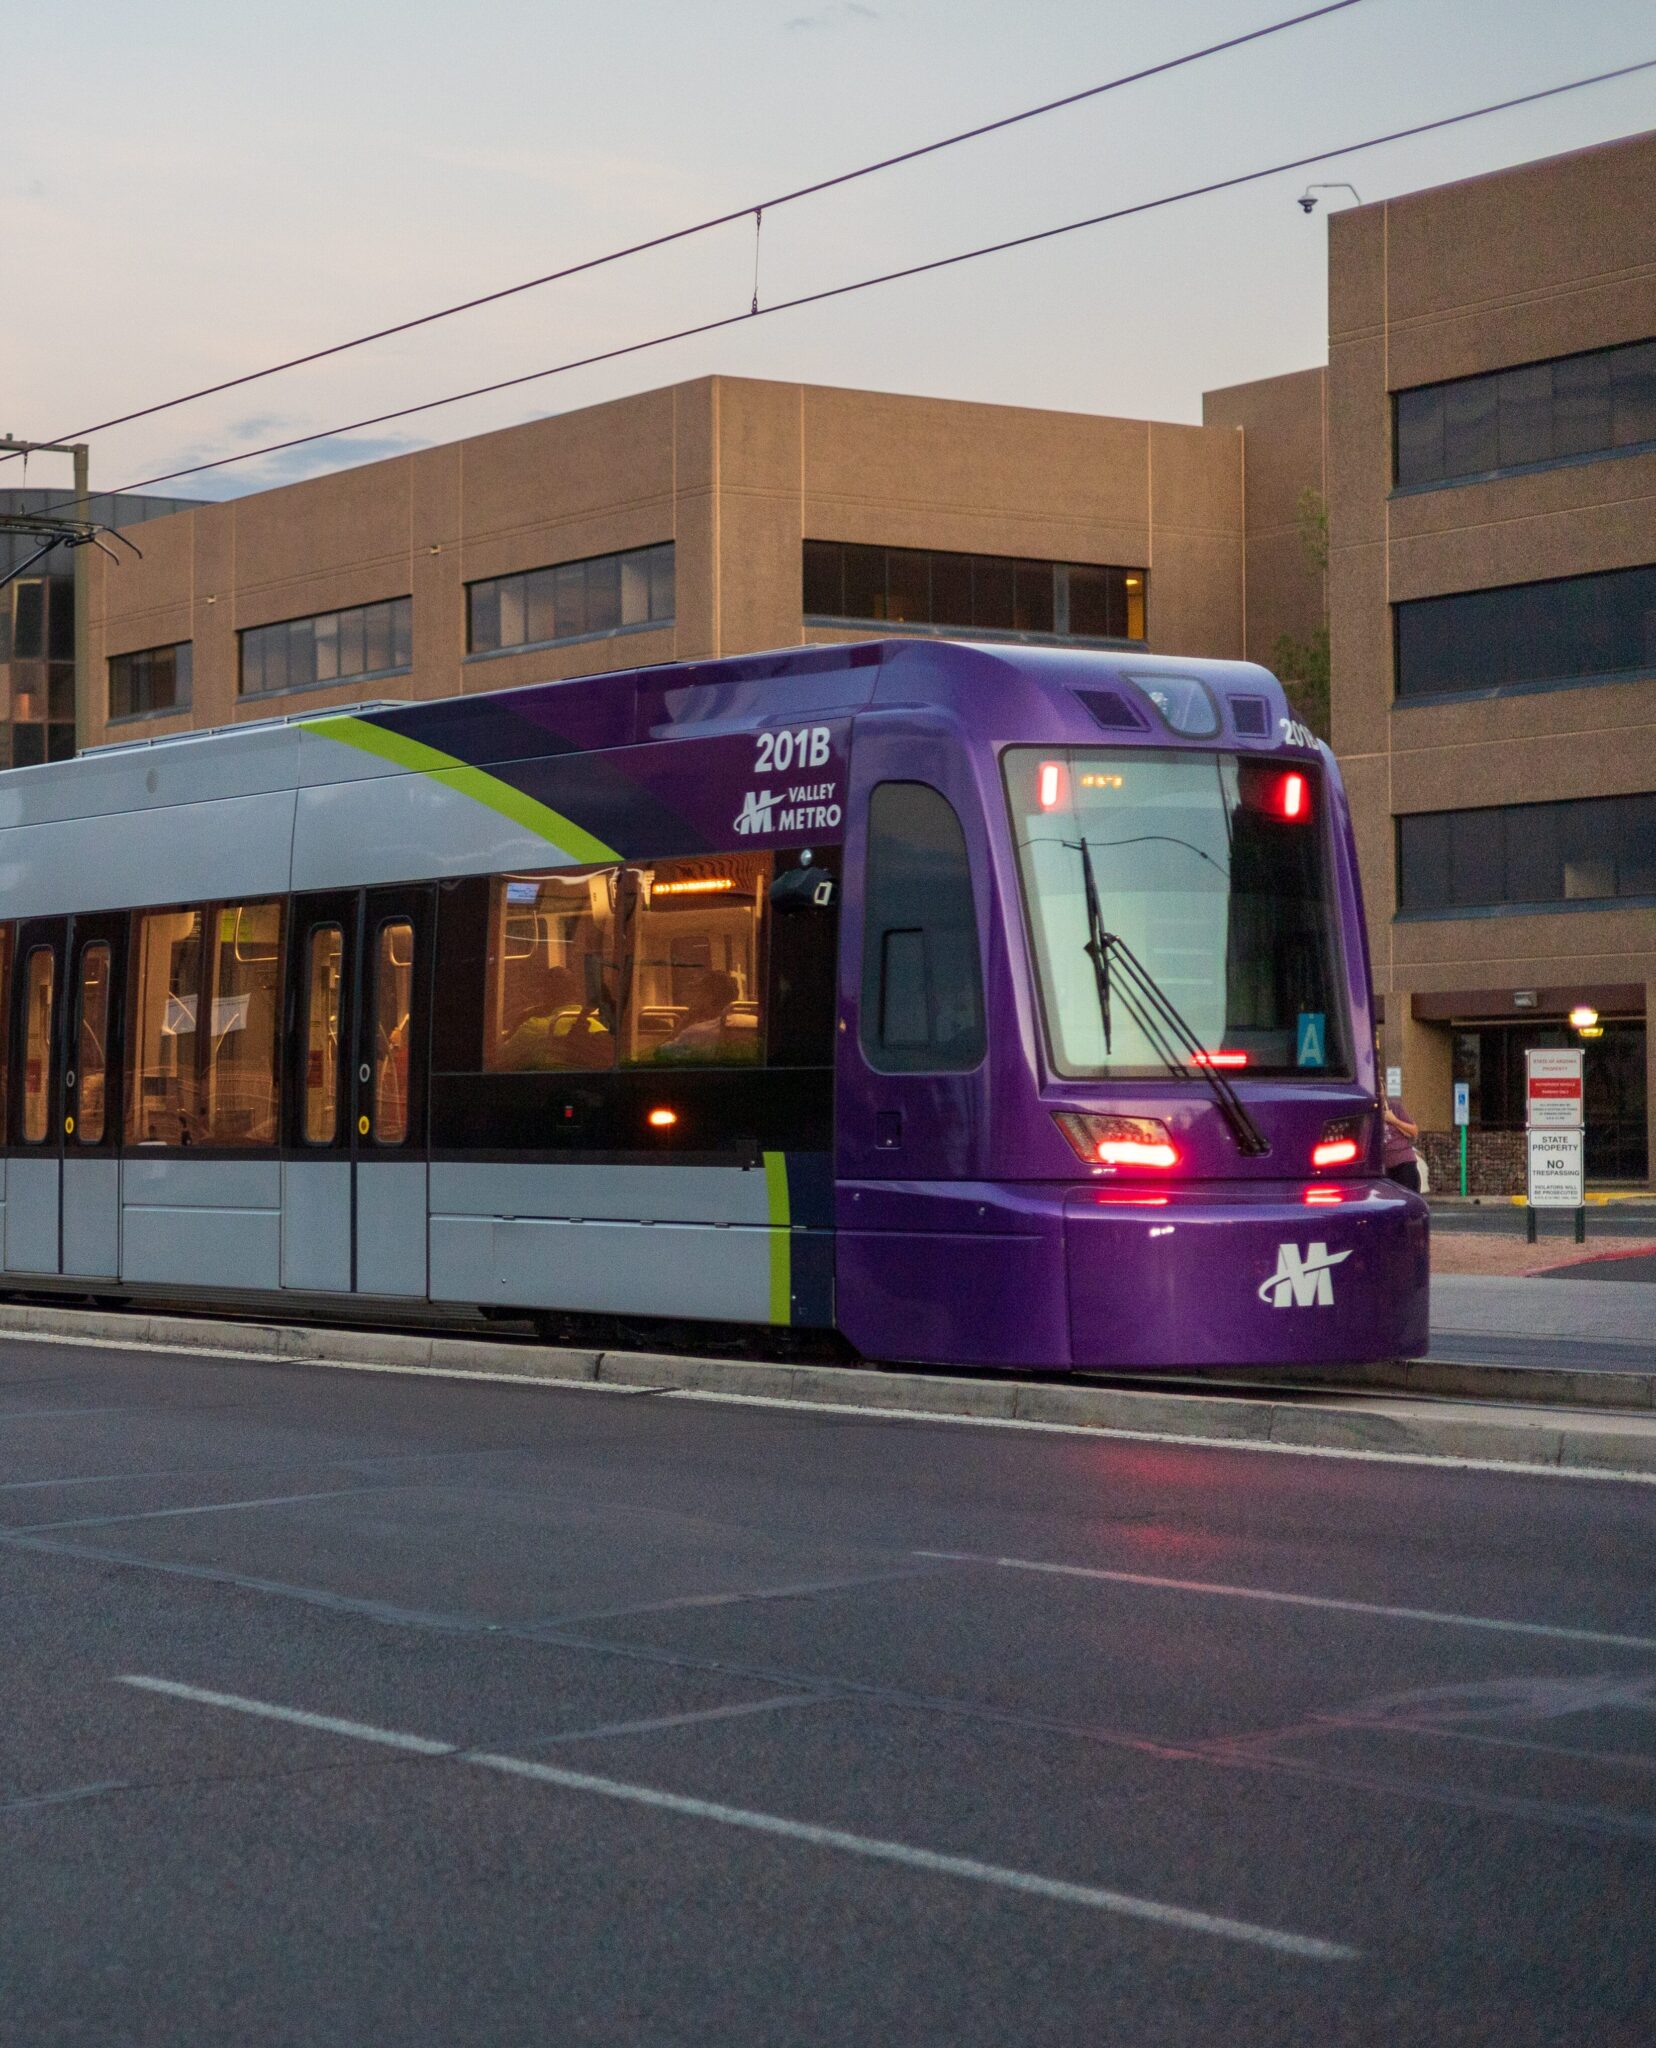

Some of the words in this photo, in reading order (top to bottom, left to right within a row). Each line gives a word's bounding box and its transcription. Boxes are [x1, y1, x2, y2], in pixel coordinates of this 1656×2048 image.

[754, 726, 831, 773] 201B
[788, 782, 837, 803] VALLEY
[778, 803, 842, 832] METRO
[1299, 1023, 1322, 1066] A
[1532, 1144, 1579, 1152] PROPERTY
[1542, 1135, 1569, 1144] STATE
[1546, 1159, 1565, 1169] NO
